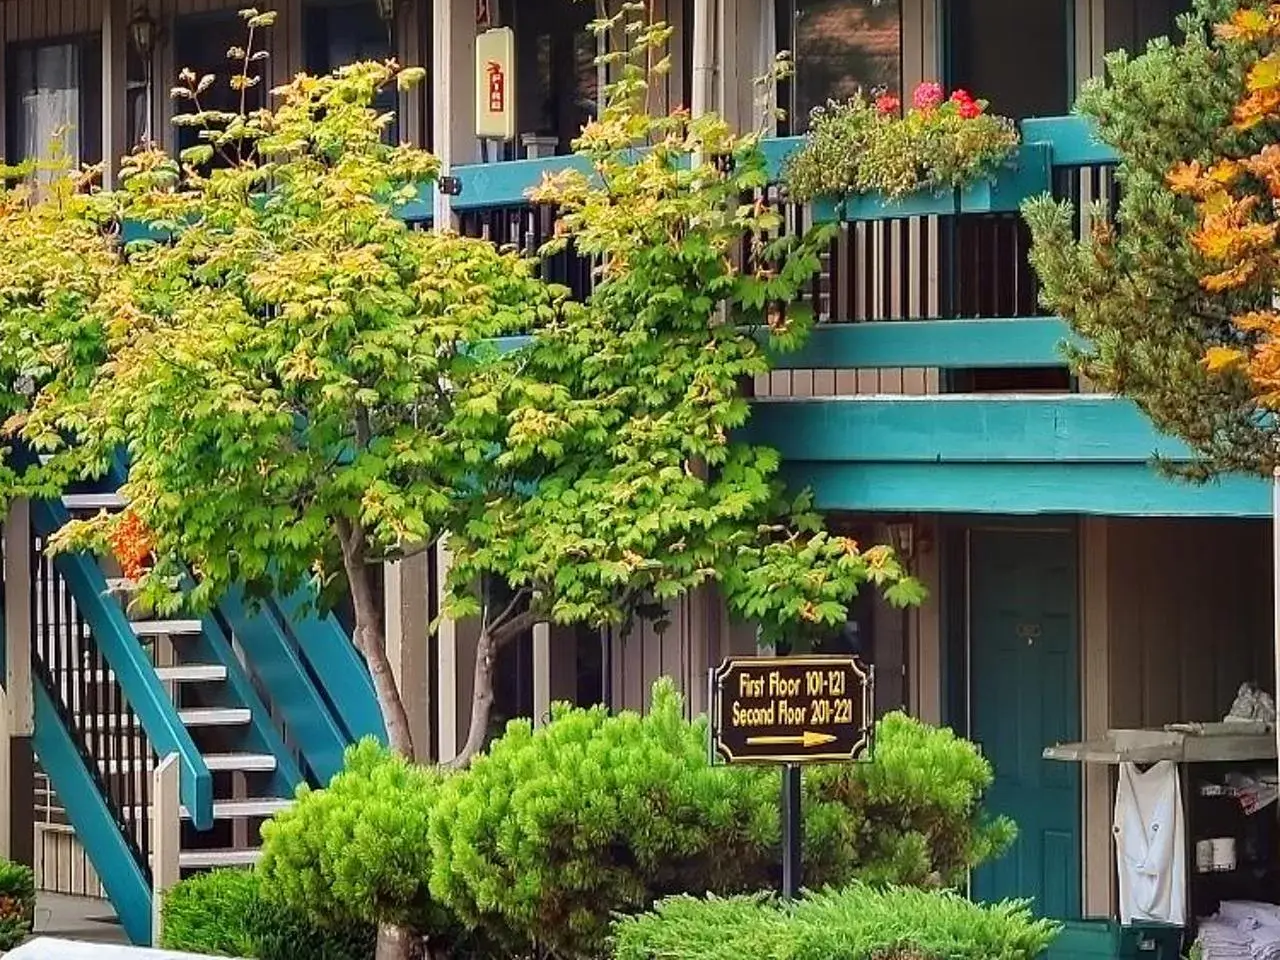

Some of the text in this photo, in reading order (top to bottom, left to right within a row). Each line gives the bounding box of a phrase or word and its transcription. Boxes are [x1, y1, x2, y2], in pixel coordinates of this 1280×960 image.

[739, 670, 846, 698] First Floor 101-121
[732, 698, 853, 727] Second Floor 201-221
